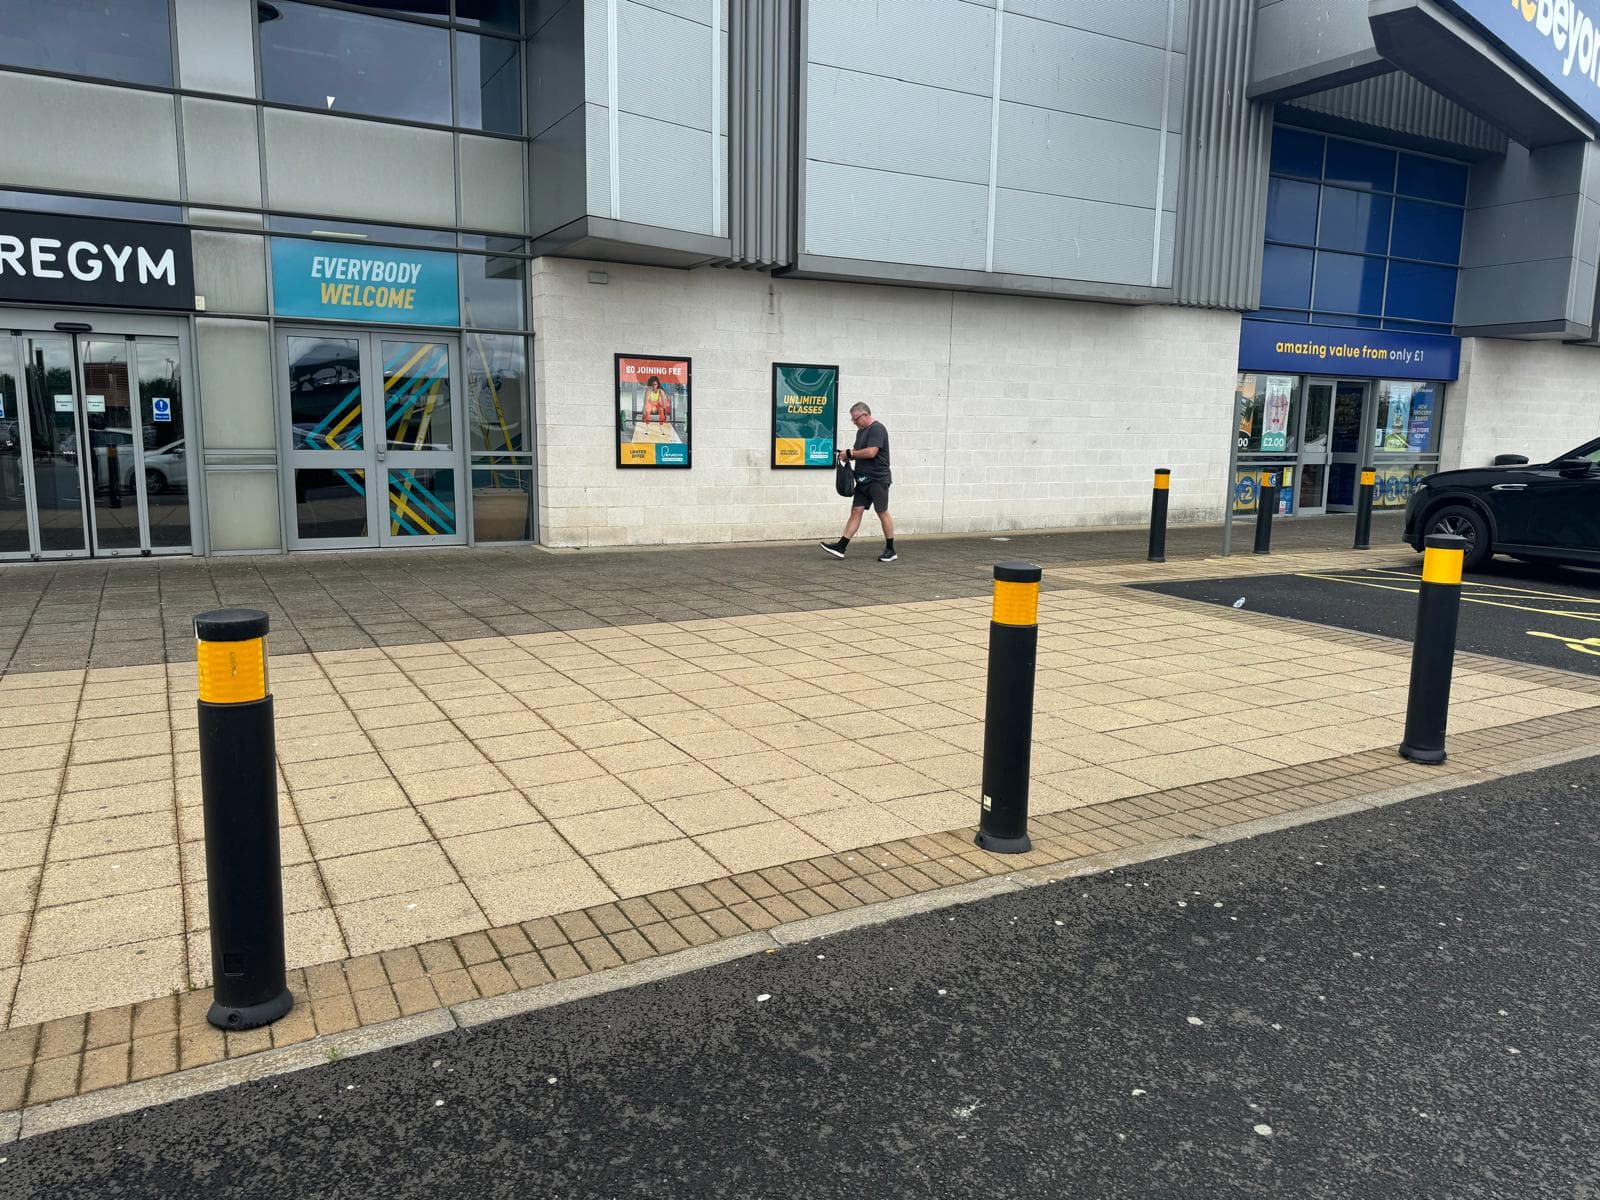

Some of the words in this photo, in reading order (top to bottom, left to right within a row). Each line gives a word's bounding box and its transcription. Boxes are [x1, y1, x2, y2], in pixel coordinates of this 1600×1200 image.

[0, 235, 176, 286] REGYM
[311, 256, 422, 284] EVERYBODY
[321, 283, 416, 309] WELCOME
[1276, 341, 1326, 358] amazing
[1330, 344, 1360, 357] value
[1362, 346, 1387, 359] from
[1390, 349, 1412, 363] only
[1414, 350, 1424, 361] £1
[636, 366, 667, 375] JOINING
[668, 367, 682, 376] FEE
[783, 394, 827, 405] UNLIMITED
[787, 405, 823, 414] CLASSES
[1263, 437, 1284, 447] £2.00
